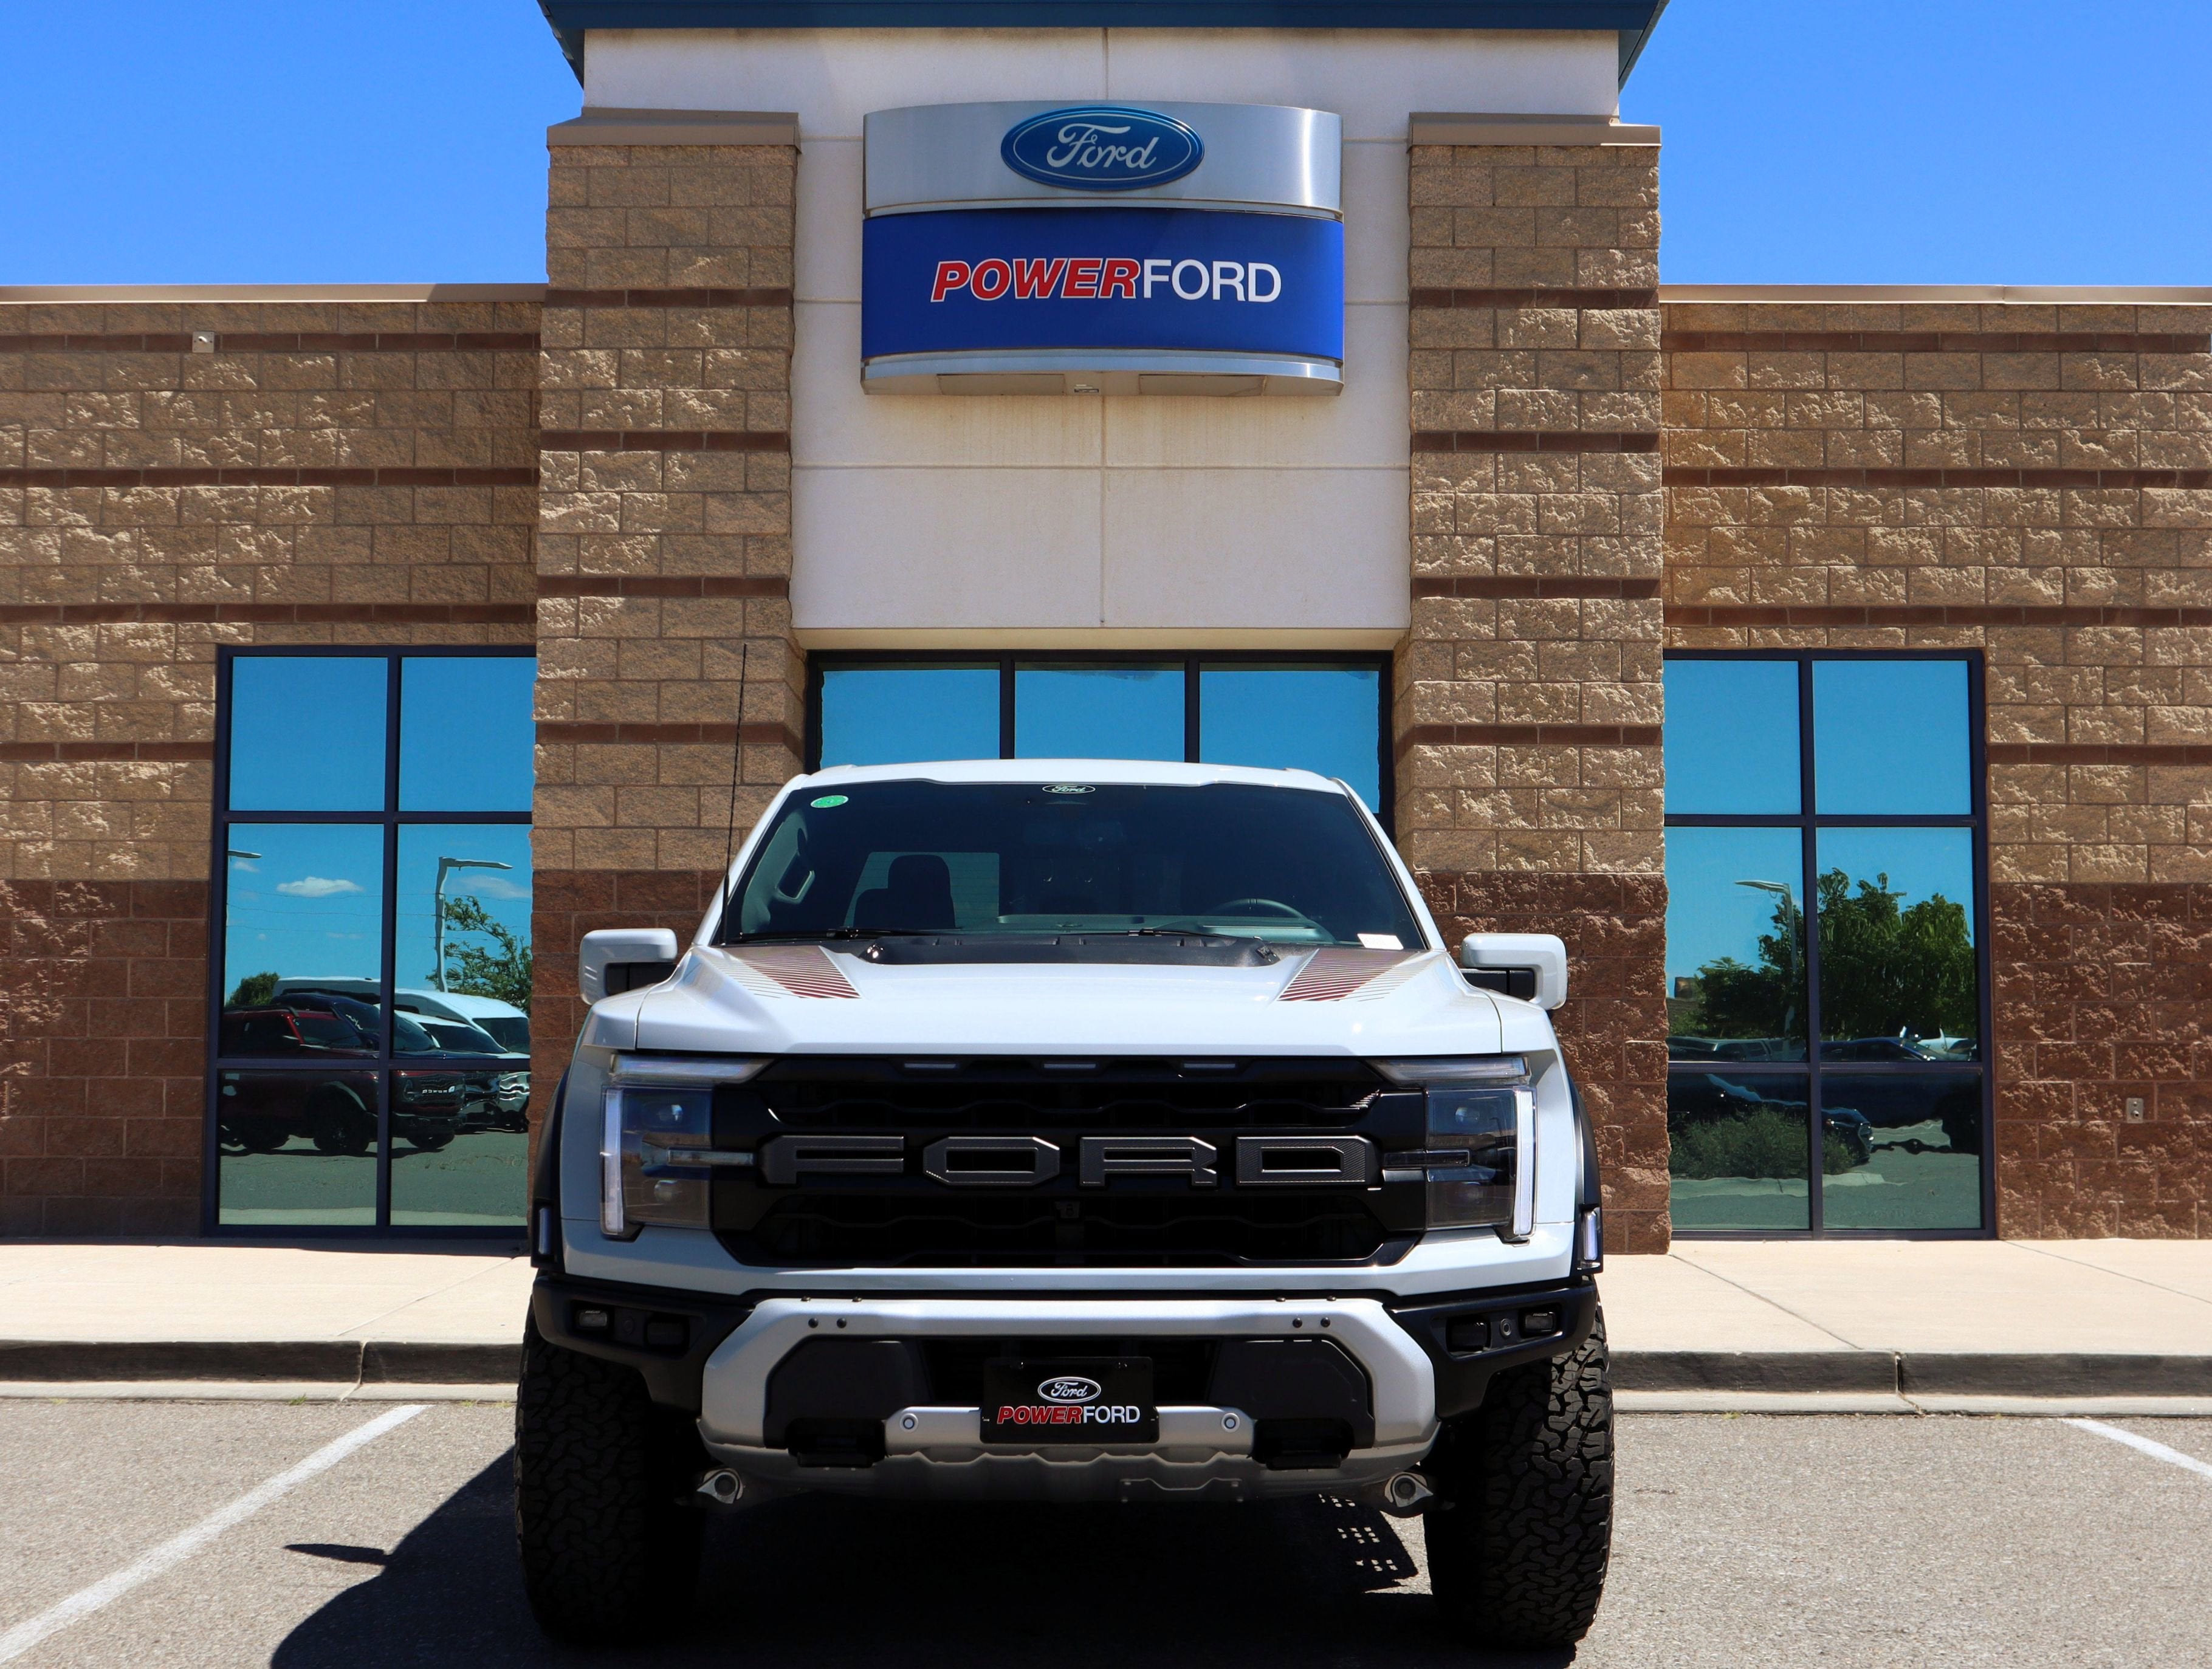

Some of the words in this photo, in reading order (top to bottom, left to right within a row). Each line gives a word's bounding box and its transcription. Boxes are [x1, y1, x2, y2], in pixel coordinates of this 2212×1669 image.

[1046, 123, 1159, 169] Ford
[761, 1135, 1378, 1185] FORD
[1051, 1381, 1088, 1397] Ford
